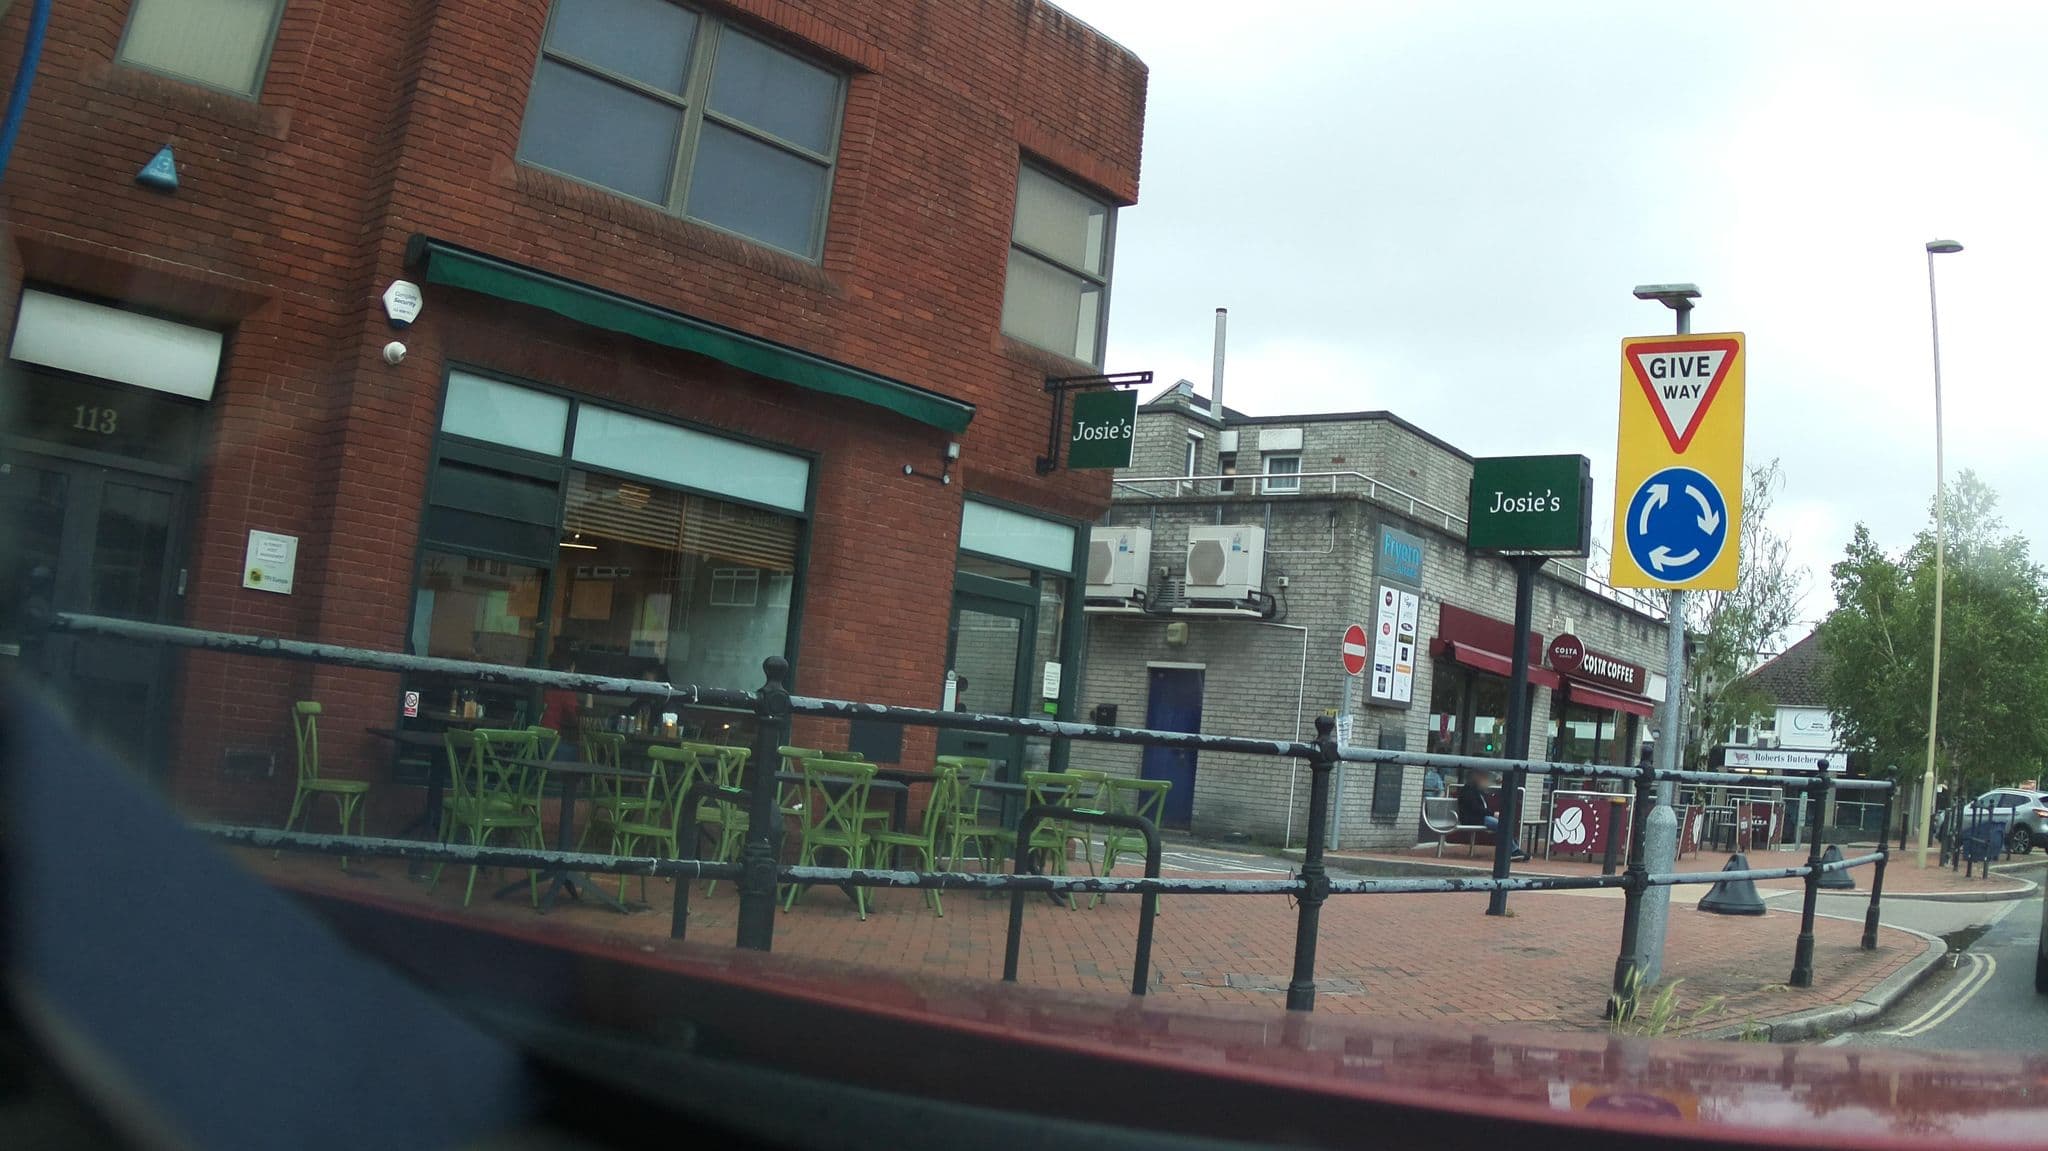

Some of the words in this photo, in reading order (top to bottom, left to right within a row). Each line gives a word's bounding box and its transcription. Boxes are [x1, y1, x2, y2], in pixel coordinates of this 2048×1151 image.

[393, 297, 417, 308] Security
[1649, 355, 1711, 379] GIVE
[1663, 384, 1702, 400] WAY
[73, 405, 118, 434] 113
[1072, 418, 1132, 441] Josie's
[1489, 489, 1561, 513] Josie's
[1384, 531, 1420, 566] Fryern
[1554, 646, 1578, 656] COSTA
[1583, 653, 1606, 676] COSTA
[1607, 661, 1635, 684] COFFEE
[1755, 752, 1785, 763] Roberts
[1786, 754, 1818, 764] Butcher
